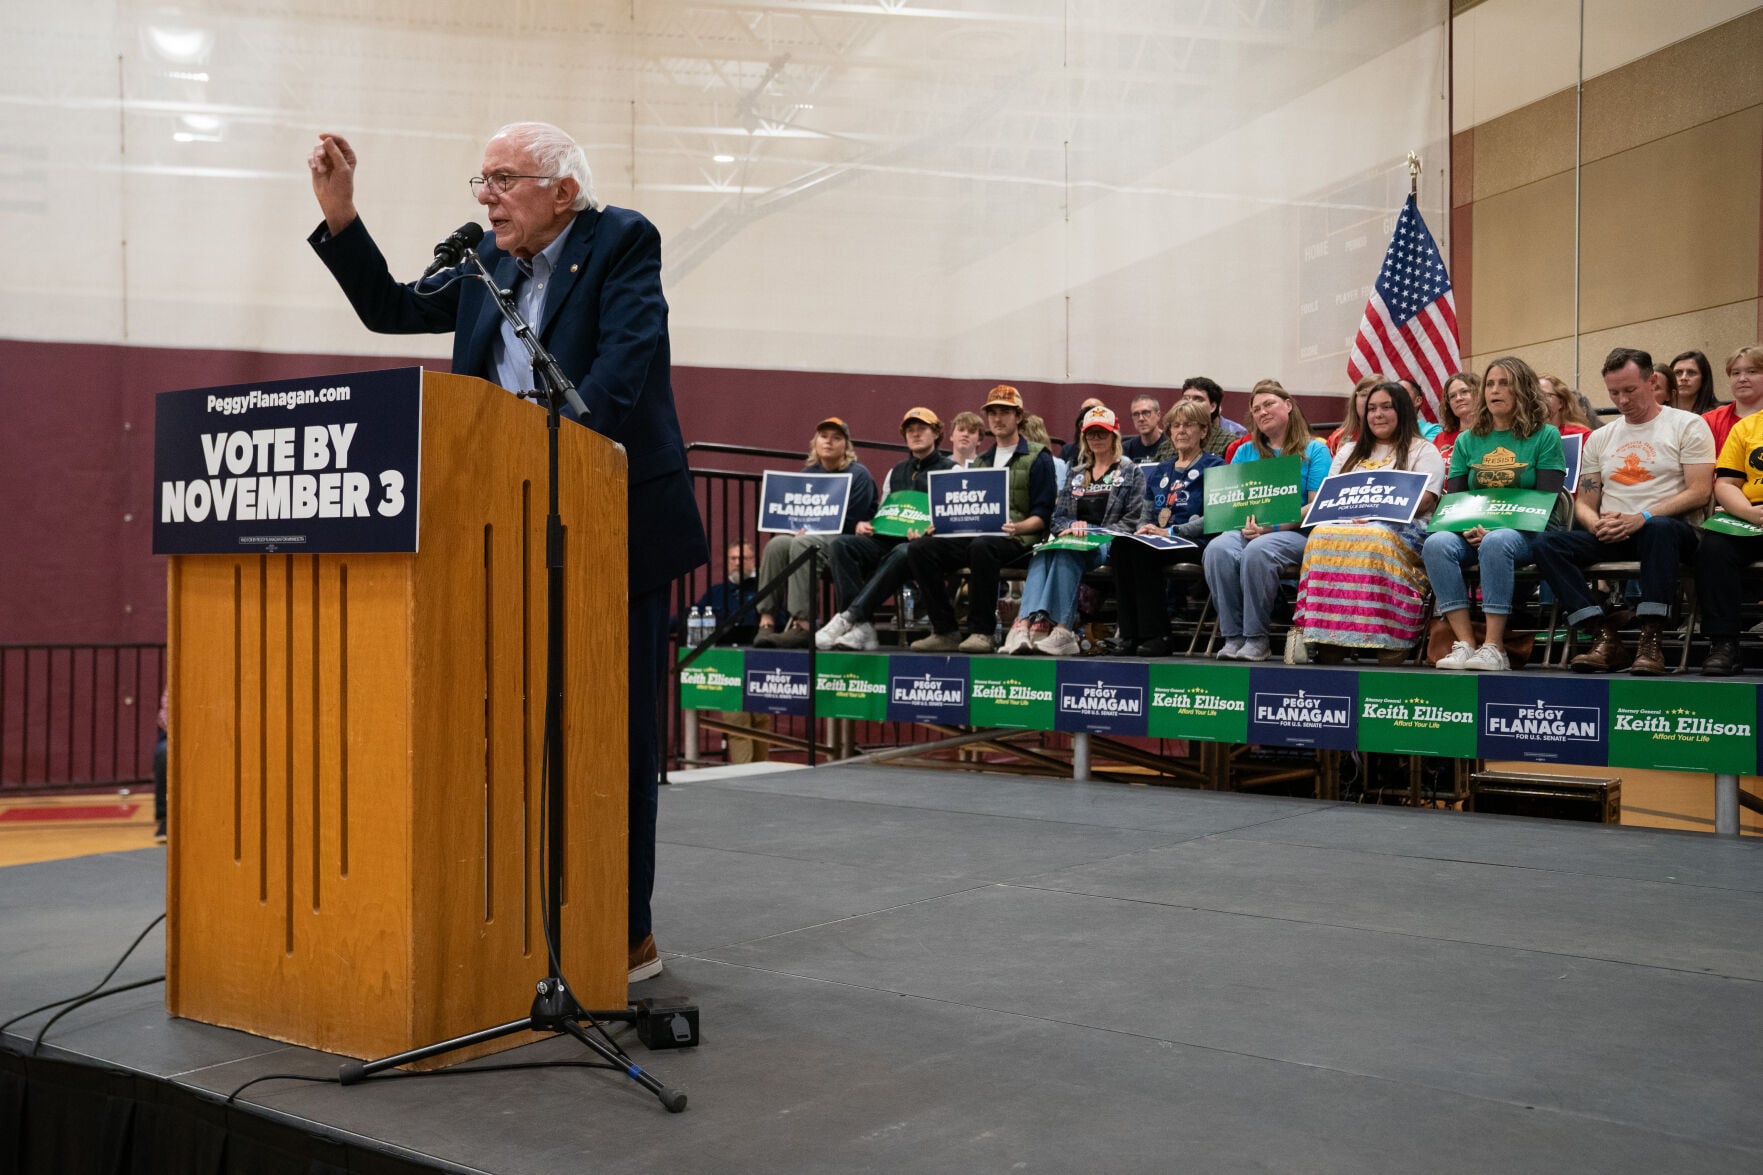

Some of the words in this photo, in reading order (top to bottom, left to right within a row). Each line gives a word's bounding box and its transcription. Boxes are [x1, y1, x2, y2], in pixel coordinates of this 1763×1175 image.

[1305, 240, 1328, 262] HOME
[207, 385, 351, 415] PeggyFlanagan.com
[201, 427, 296, 476] VOTE
[303, 423, 358, 471] BY
[1485, 456, 1515, 464] RESIST
[161, 471, 371, 523] NOVEMBER
[377, 469, 405, 517] 3
[784, 492, 830, 505] PEGGY
[945, 490, 987, 504] PEGGY
[1207, 490, 1245, 506] Keith
[1247, 484, 1298, 500] Ellison
[1338, 485, 1397, 498] PEGGY
[769, 502, 840, 517] FLANAGAN
[935, 502, 1000, 517] FLANAGAN
[1318, 494, 1410, 510] FLANAGAN
[1486, 503, 1547, 515] Ellison
[681, 671, 706, 684] Keith
[707, 673, 741, 687] Ellison
[816, 678, 847, 691] Keith
[848, 679, 887, 694] Ellison
[914, 681, 942, 690] PEGGY
[750, 681, 807, 696] FLANAGAN
[895, 688, 961, 703] FLANAGAN
[972, 684, 1006, 699] Keith
[1009, 686, 1053, 701] Ellison
[1084, 687, 1117, 698] PEGGY
[1063, 696, 1139, 712] FLANAGAN
[1152, 693, 1191, 708] Keith
[1194, 695, 1245, 711] Ellison
[1283, 698, 1321, 709] PEGGY
[1258, 706, 1346, 724] FLANAGAN
[1362, 703, 1409, 720] Keith
[1412, 705, 1474, 723] Ellison
[1519, 708, 1565, 720] PEGGY
[1428, 721, 1440, 729] Life
[1489, 717, 1595, 737] FLANAGAN
[1614, 715, 1670, 732] Keith
[1675, 717, 1751, 736] Ellison
[1652, 733, 1676, 741] Afford
[1677, 734, 1694, 742] Your
[1696, 735, 1710, 743] Life
